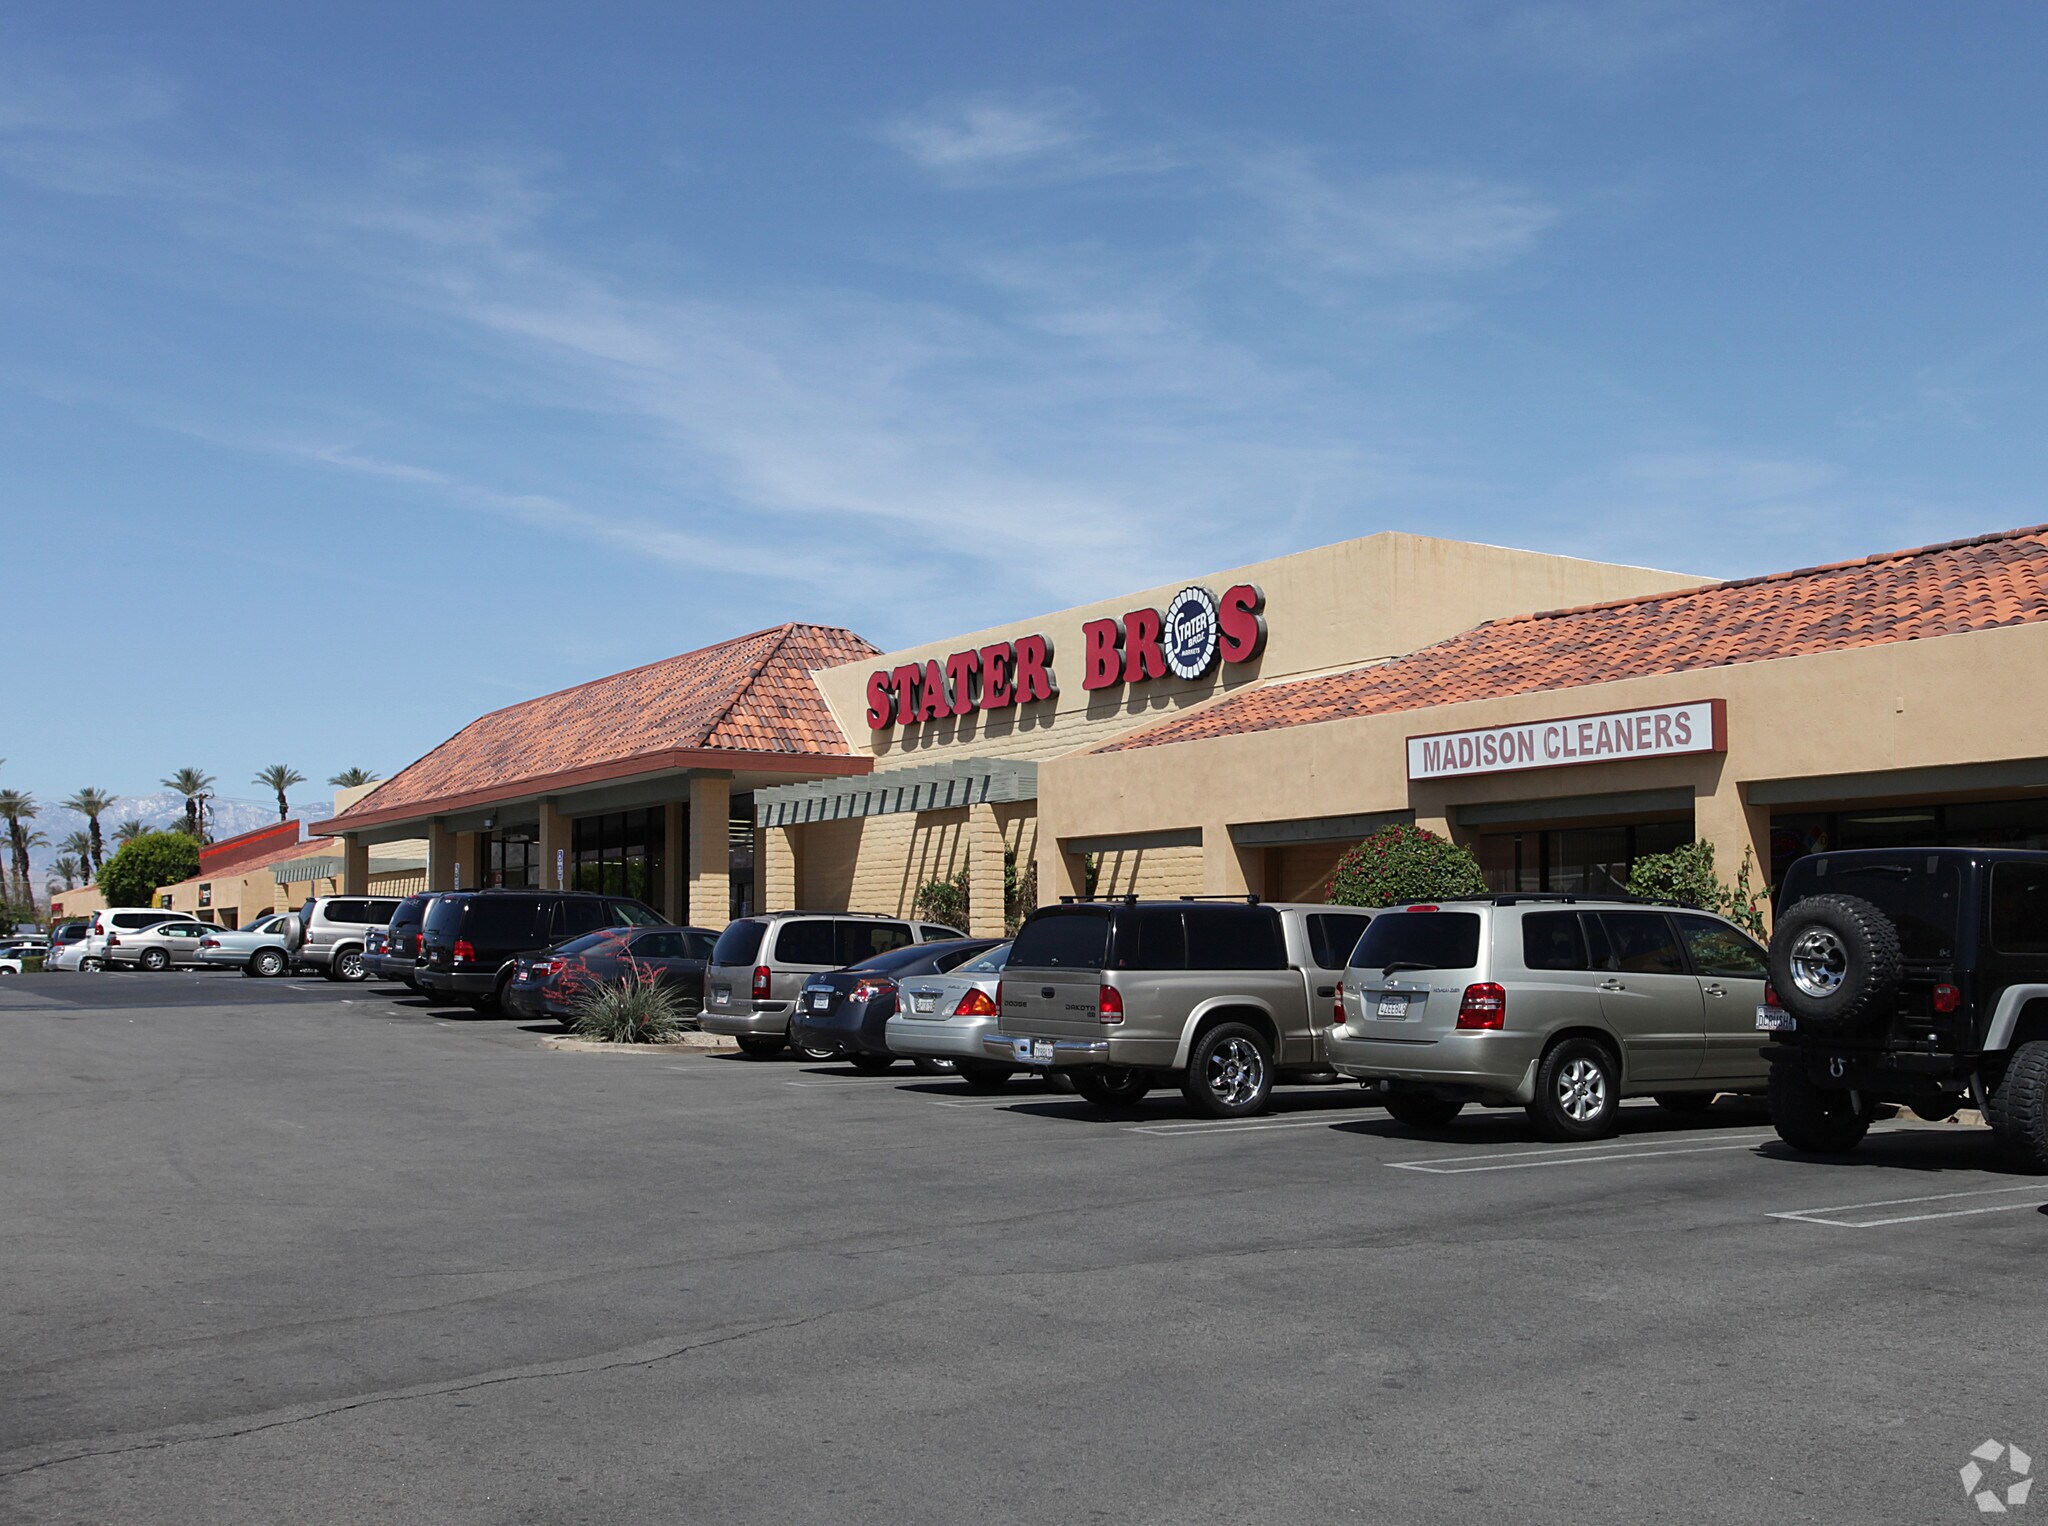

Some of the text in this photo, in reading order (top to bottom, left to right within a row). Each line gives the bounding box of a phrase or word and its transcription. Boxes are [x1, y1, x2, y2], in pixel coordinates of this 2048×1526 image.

[1174, 612, 1207, 654] STATER
[867, 633, 1057, 730] STATER
[1423, 712, 1692, 772] MADISON CLEANERS
[1065, 1003, 1096, 1011] DAKOTA
